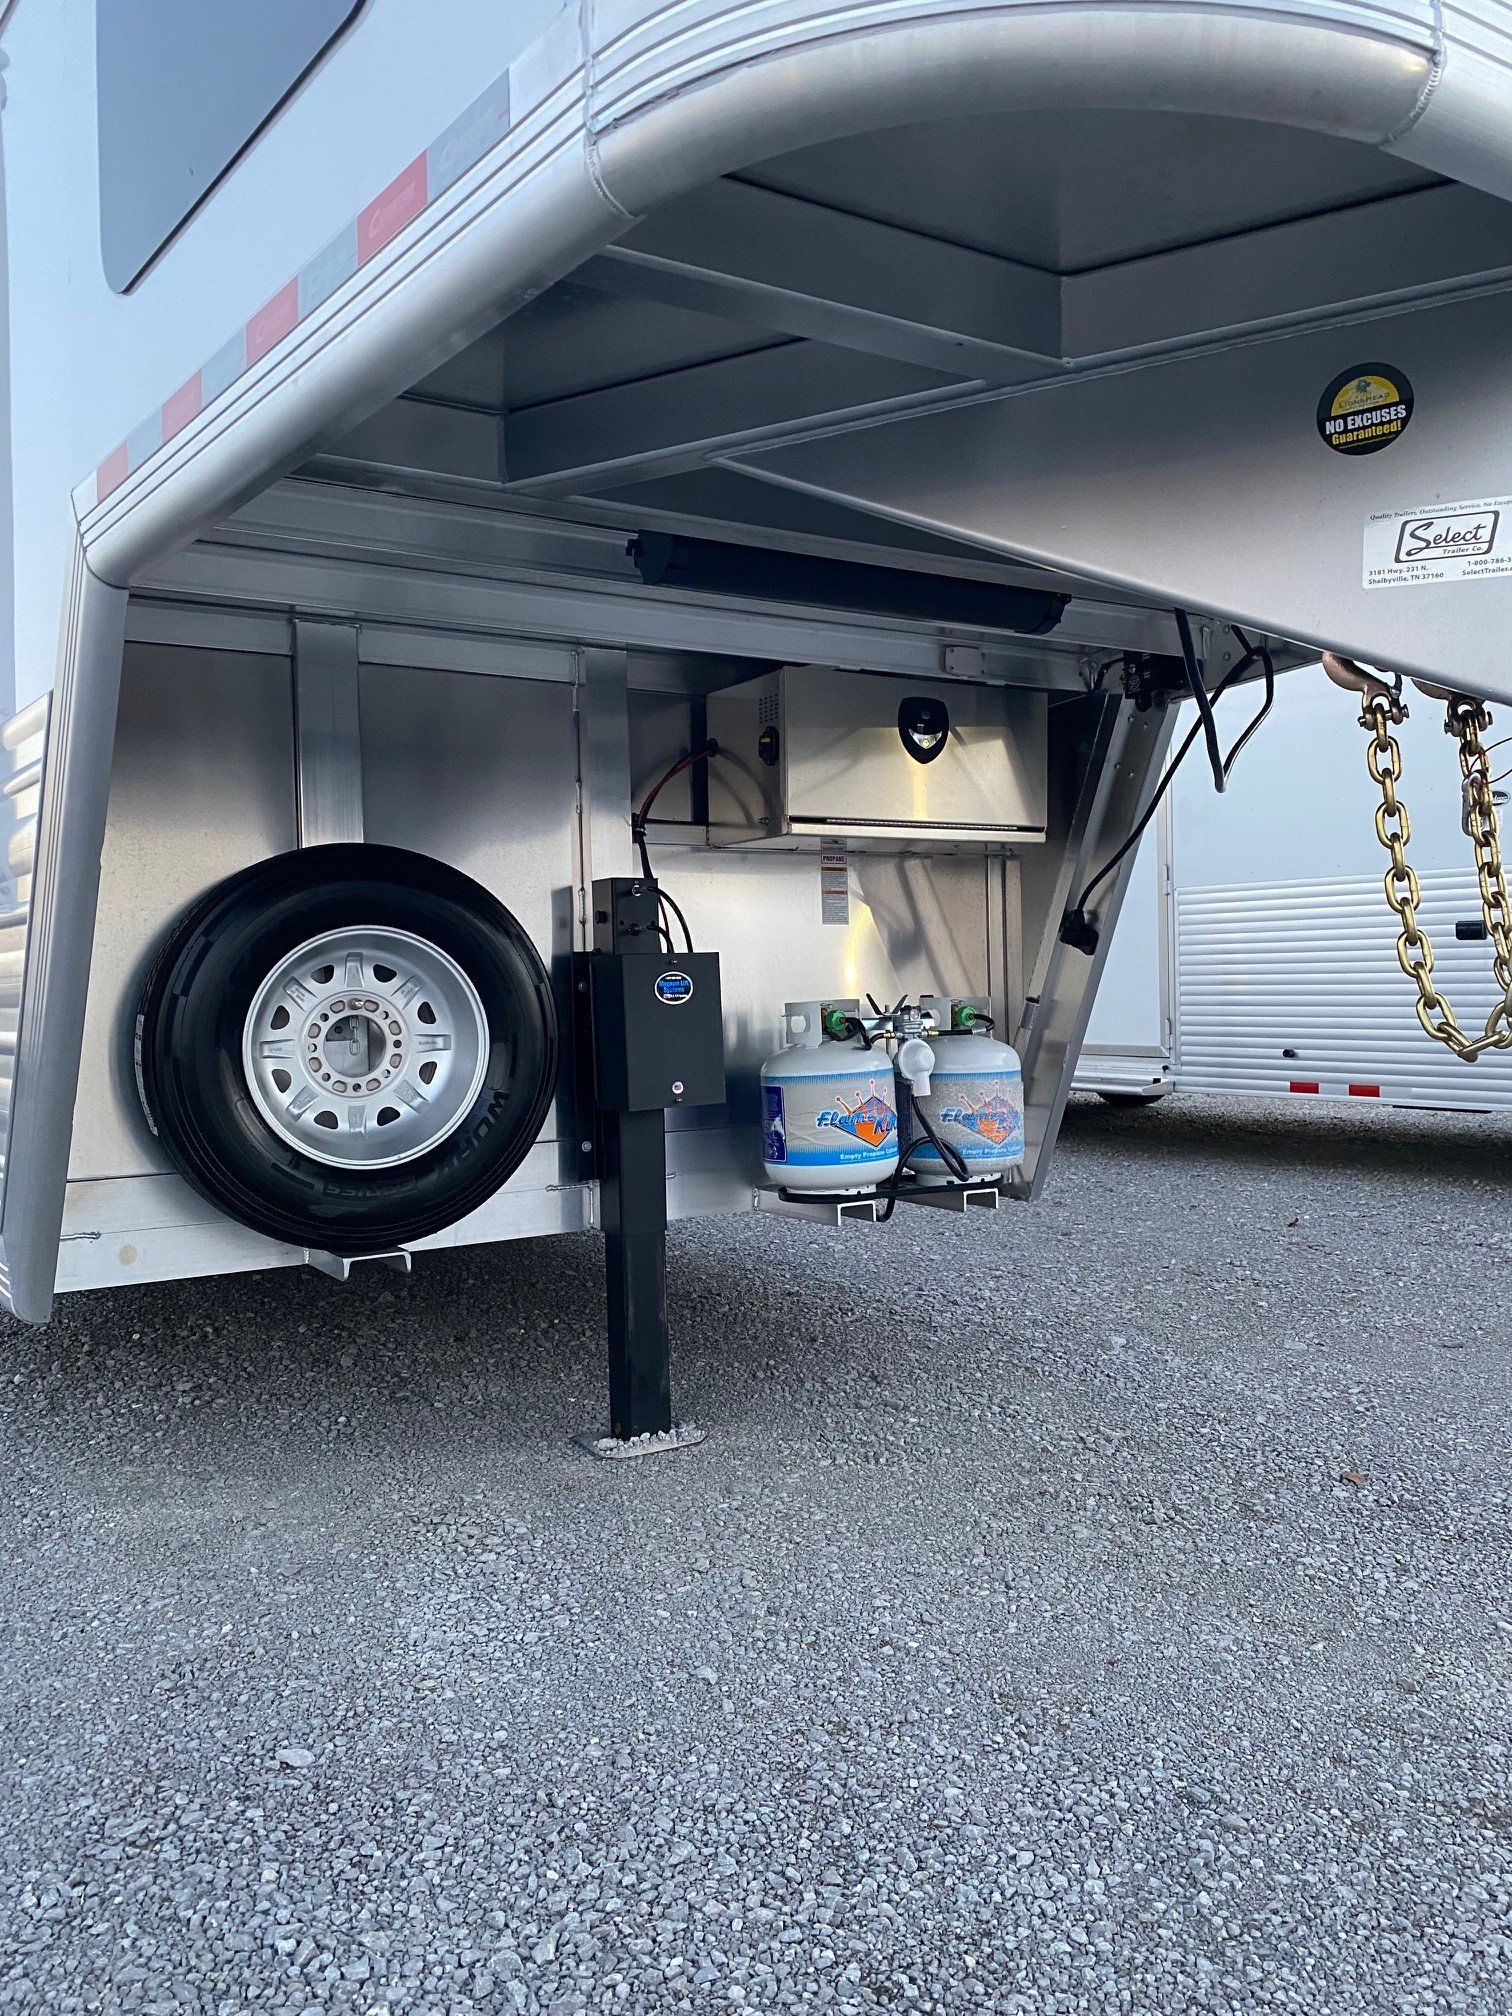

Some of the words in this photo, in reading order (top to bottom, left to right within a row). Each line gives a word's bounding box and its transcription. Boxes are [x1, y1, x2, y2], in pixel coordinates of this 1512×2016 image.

[1325, 418, 1344, 435] NO
[1346, 404, 1407, 430] EXCUSES
[1331, 419, 1402, 445] Guaranteed!
[1405, 521, 1487, 557] Select
[1442, 547, 1470, 555] Trailer
[1369, 569, 1386, 577] 3181
[1387, 567, 1405, 575] Hwy.
[1406, 565, 1419, 573] 231
[1368, 576, 1409, 585] Shelbyville,
[1422, 571, 1444, 579] 37160
[823, 855, 845, 863] PROPANE
[863, 1150, 886, 1158] Propane
